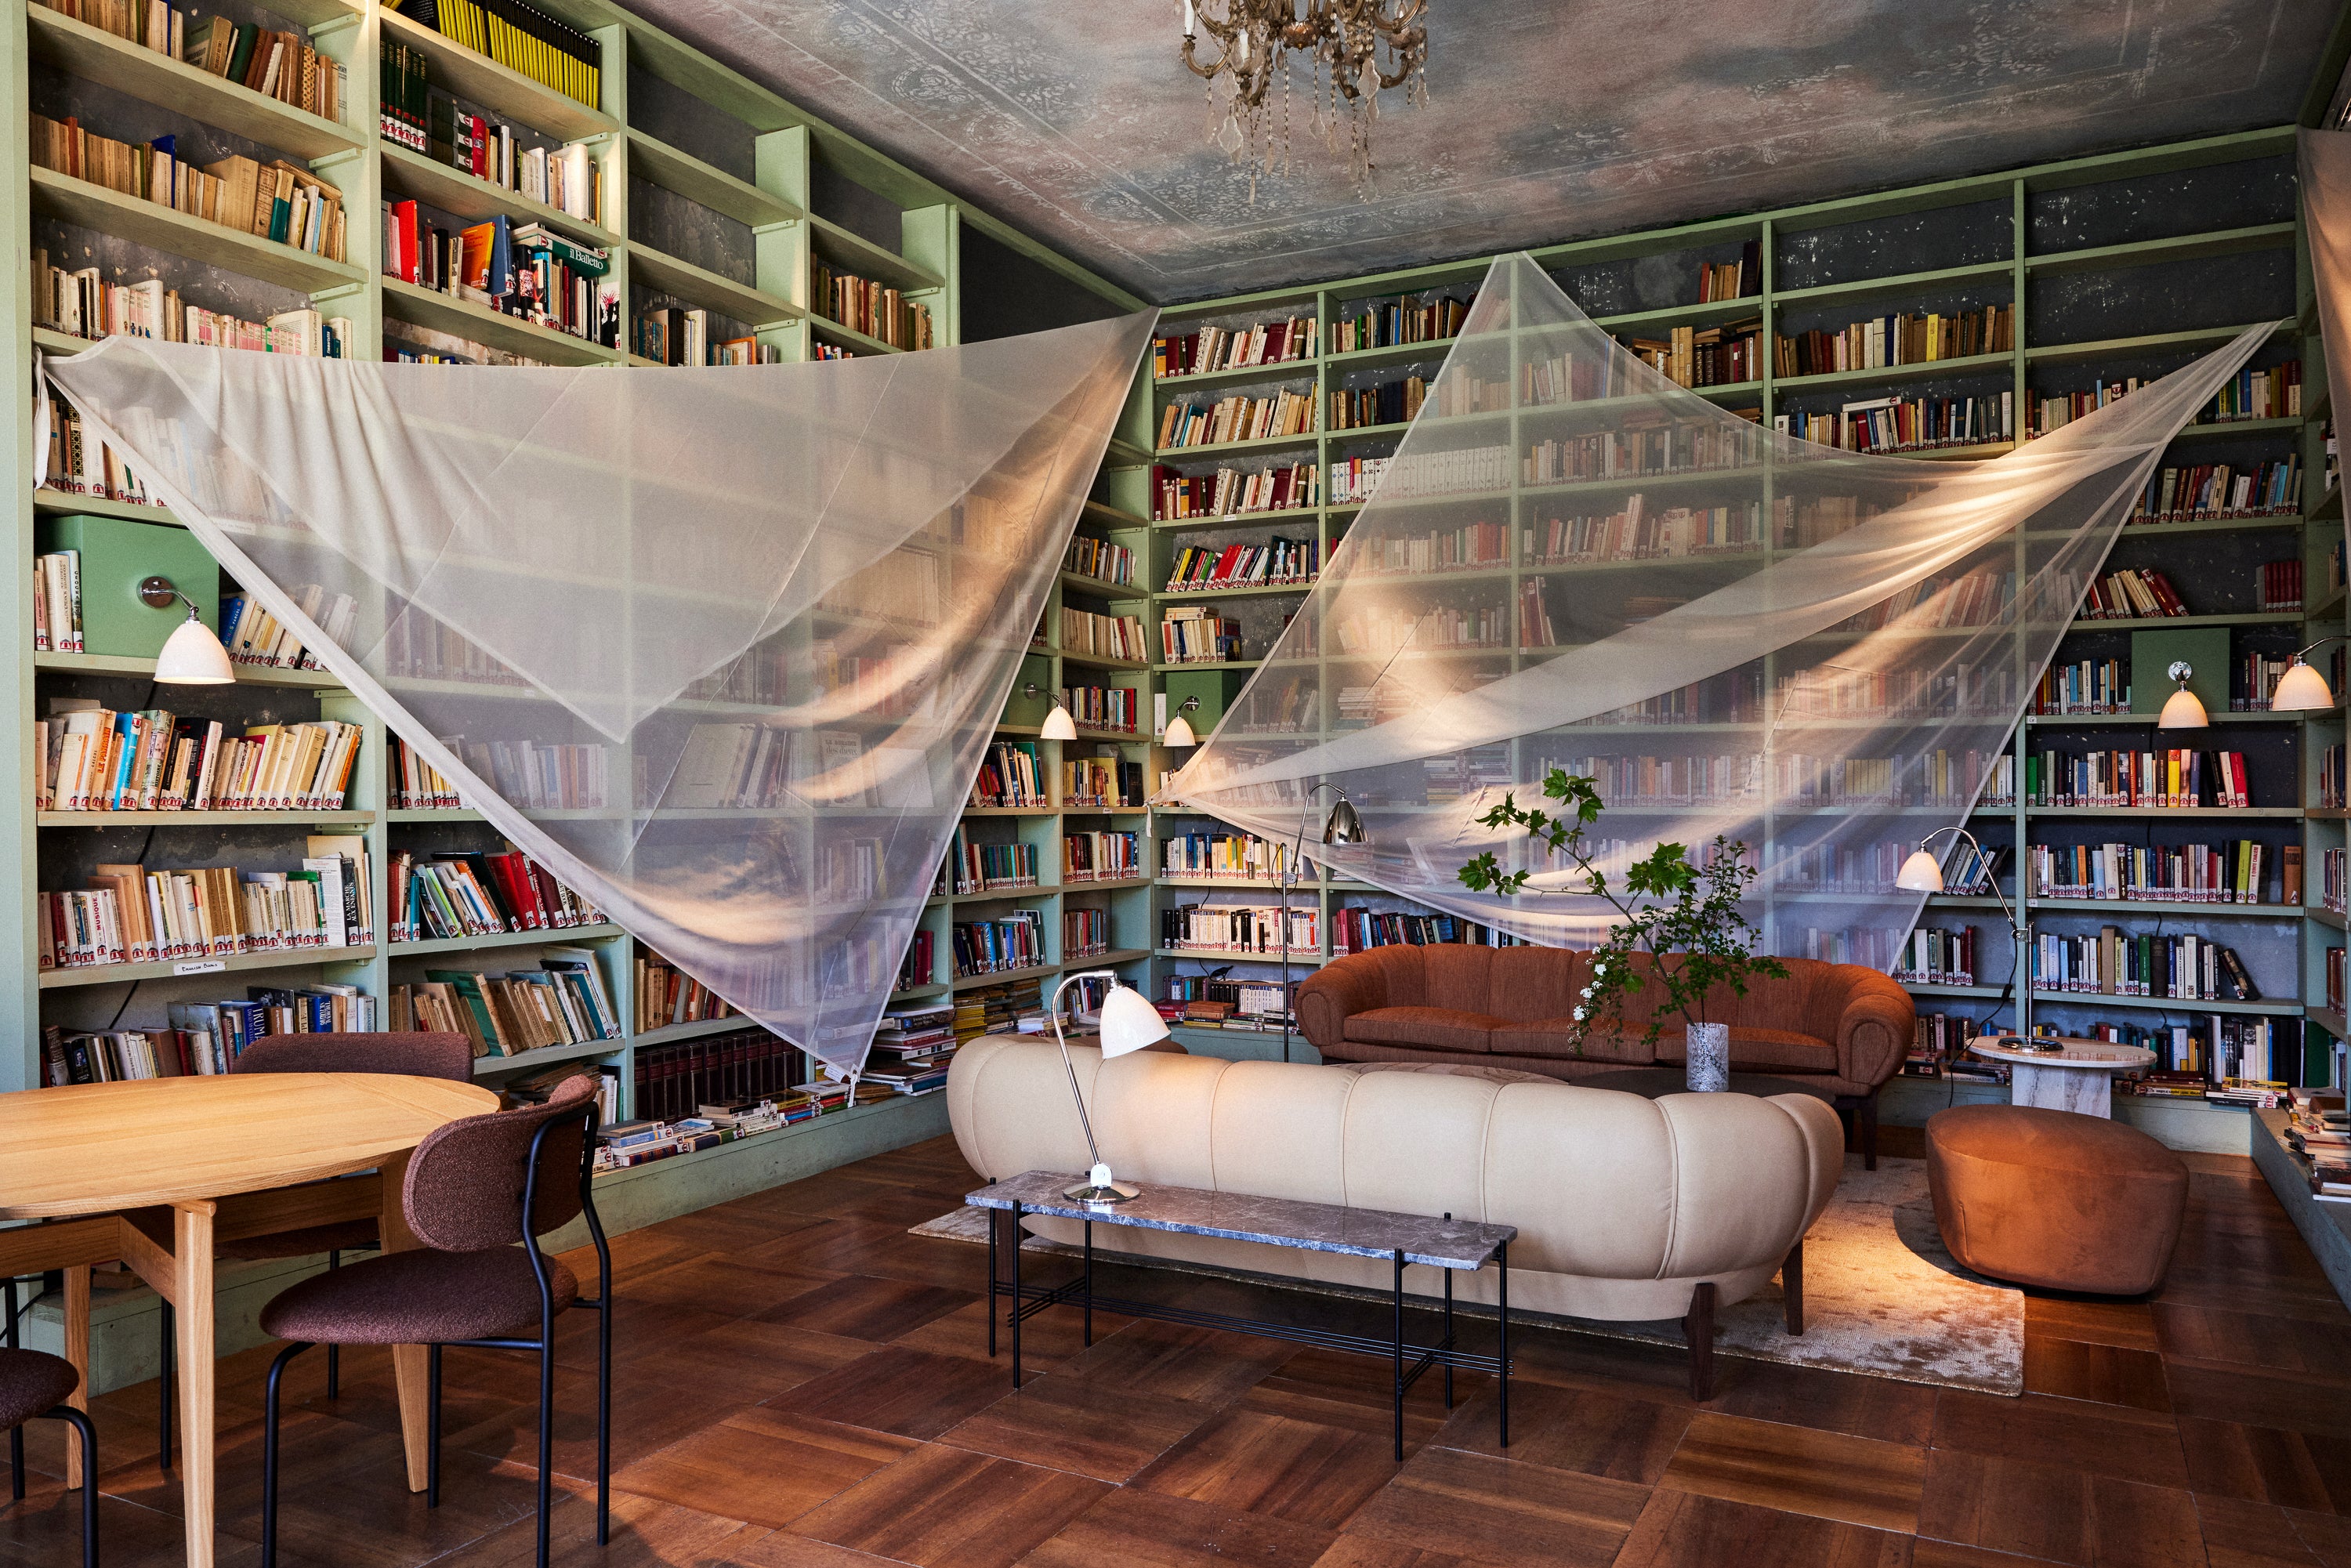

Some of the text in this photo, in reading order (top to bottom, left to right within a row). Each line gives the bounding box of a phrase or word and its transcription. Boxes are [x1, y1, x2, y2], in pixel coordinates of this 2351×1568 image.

[569, 248, 603, 270] il Balletto
[97, 726, 110, 773] LE PARRAIN
[93, 897, 102, 931] MUSIQUE
[346, 911, 352, 921] LA
[253, 1008, 266, 1041] TRUMA
